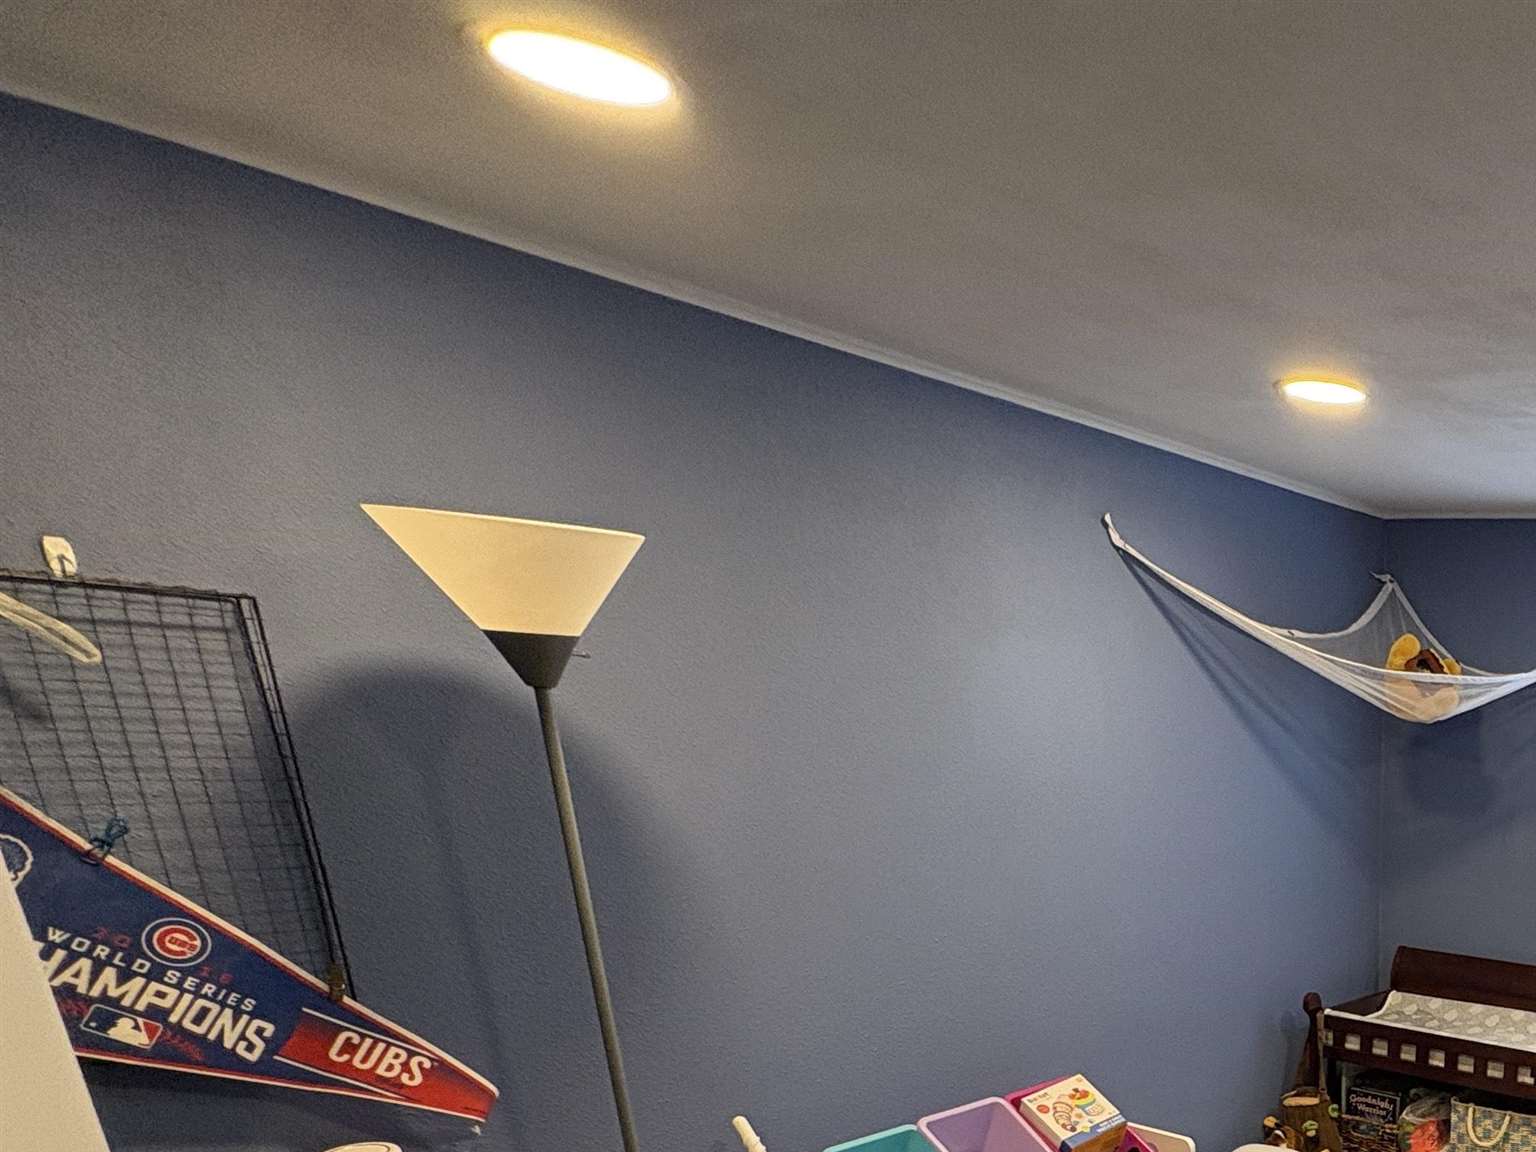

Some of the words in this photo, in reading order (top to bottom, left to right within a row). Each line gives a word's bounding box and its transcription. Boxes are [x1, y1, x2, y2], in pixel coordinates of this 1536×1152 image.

[38, 940, 277, 1064] HAMPIONS
[47, 926, 152, 974] WORLD
[163, 969, 258, 1012] SERIES
[327, 1030, 433, 1087] CUBS
